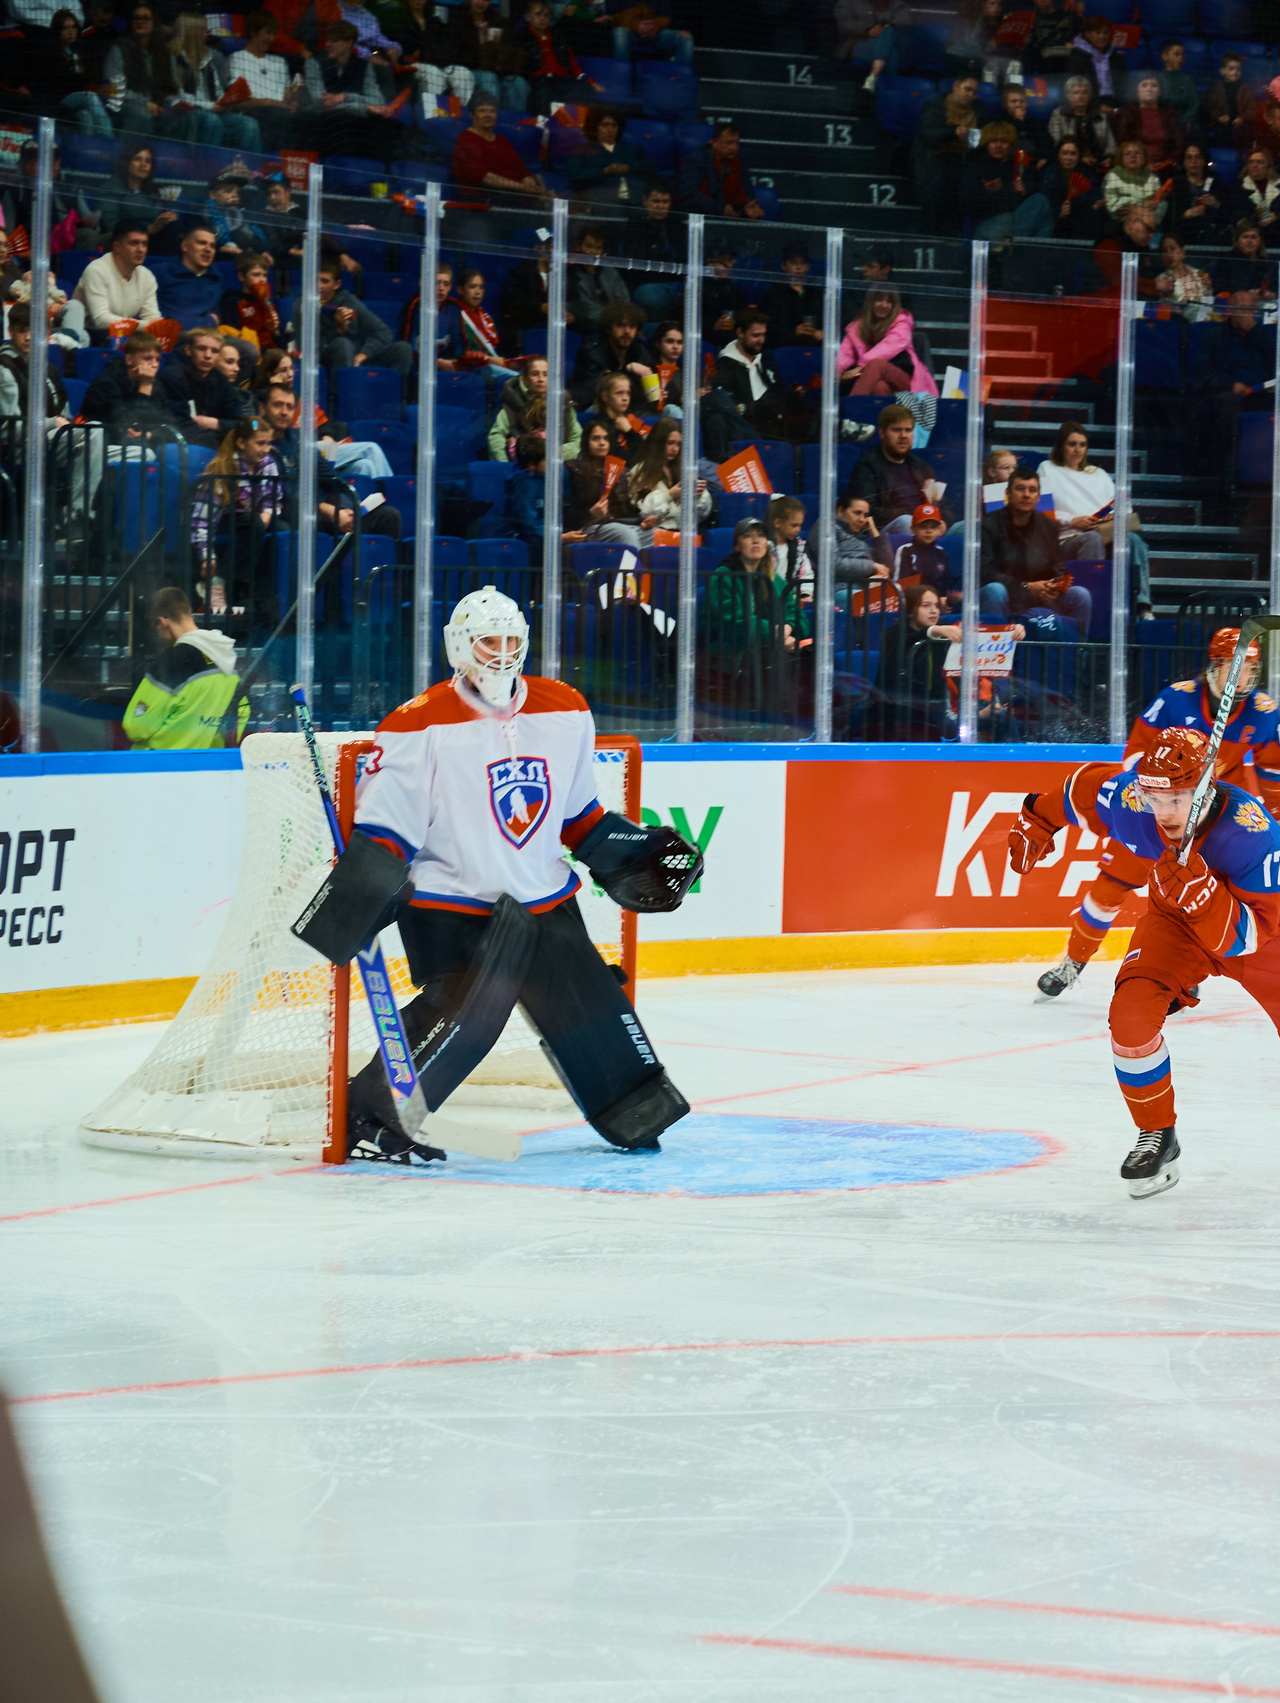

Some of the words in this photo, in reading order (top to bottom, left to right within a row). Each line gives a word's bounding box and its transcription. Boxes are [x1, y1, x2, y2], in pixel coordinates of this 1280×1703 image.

[787, 64, 812, 85] 14
[825, 124, 852, 145] 13
[869, 184, 897, 206] 12
[914, 249, 936, 270] 11
[1208, 681, 1236, 749] SOYUZ
[1155, 746, 1172, 760] 17
[489, 760, 547, 788] СХЛ
[1097, 781, 1119, 809] 17
[1183, 875, 1218, 914] CCM
[365, 970, 413, 1084] BAUER
